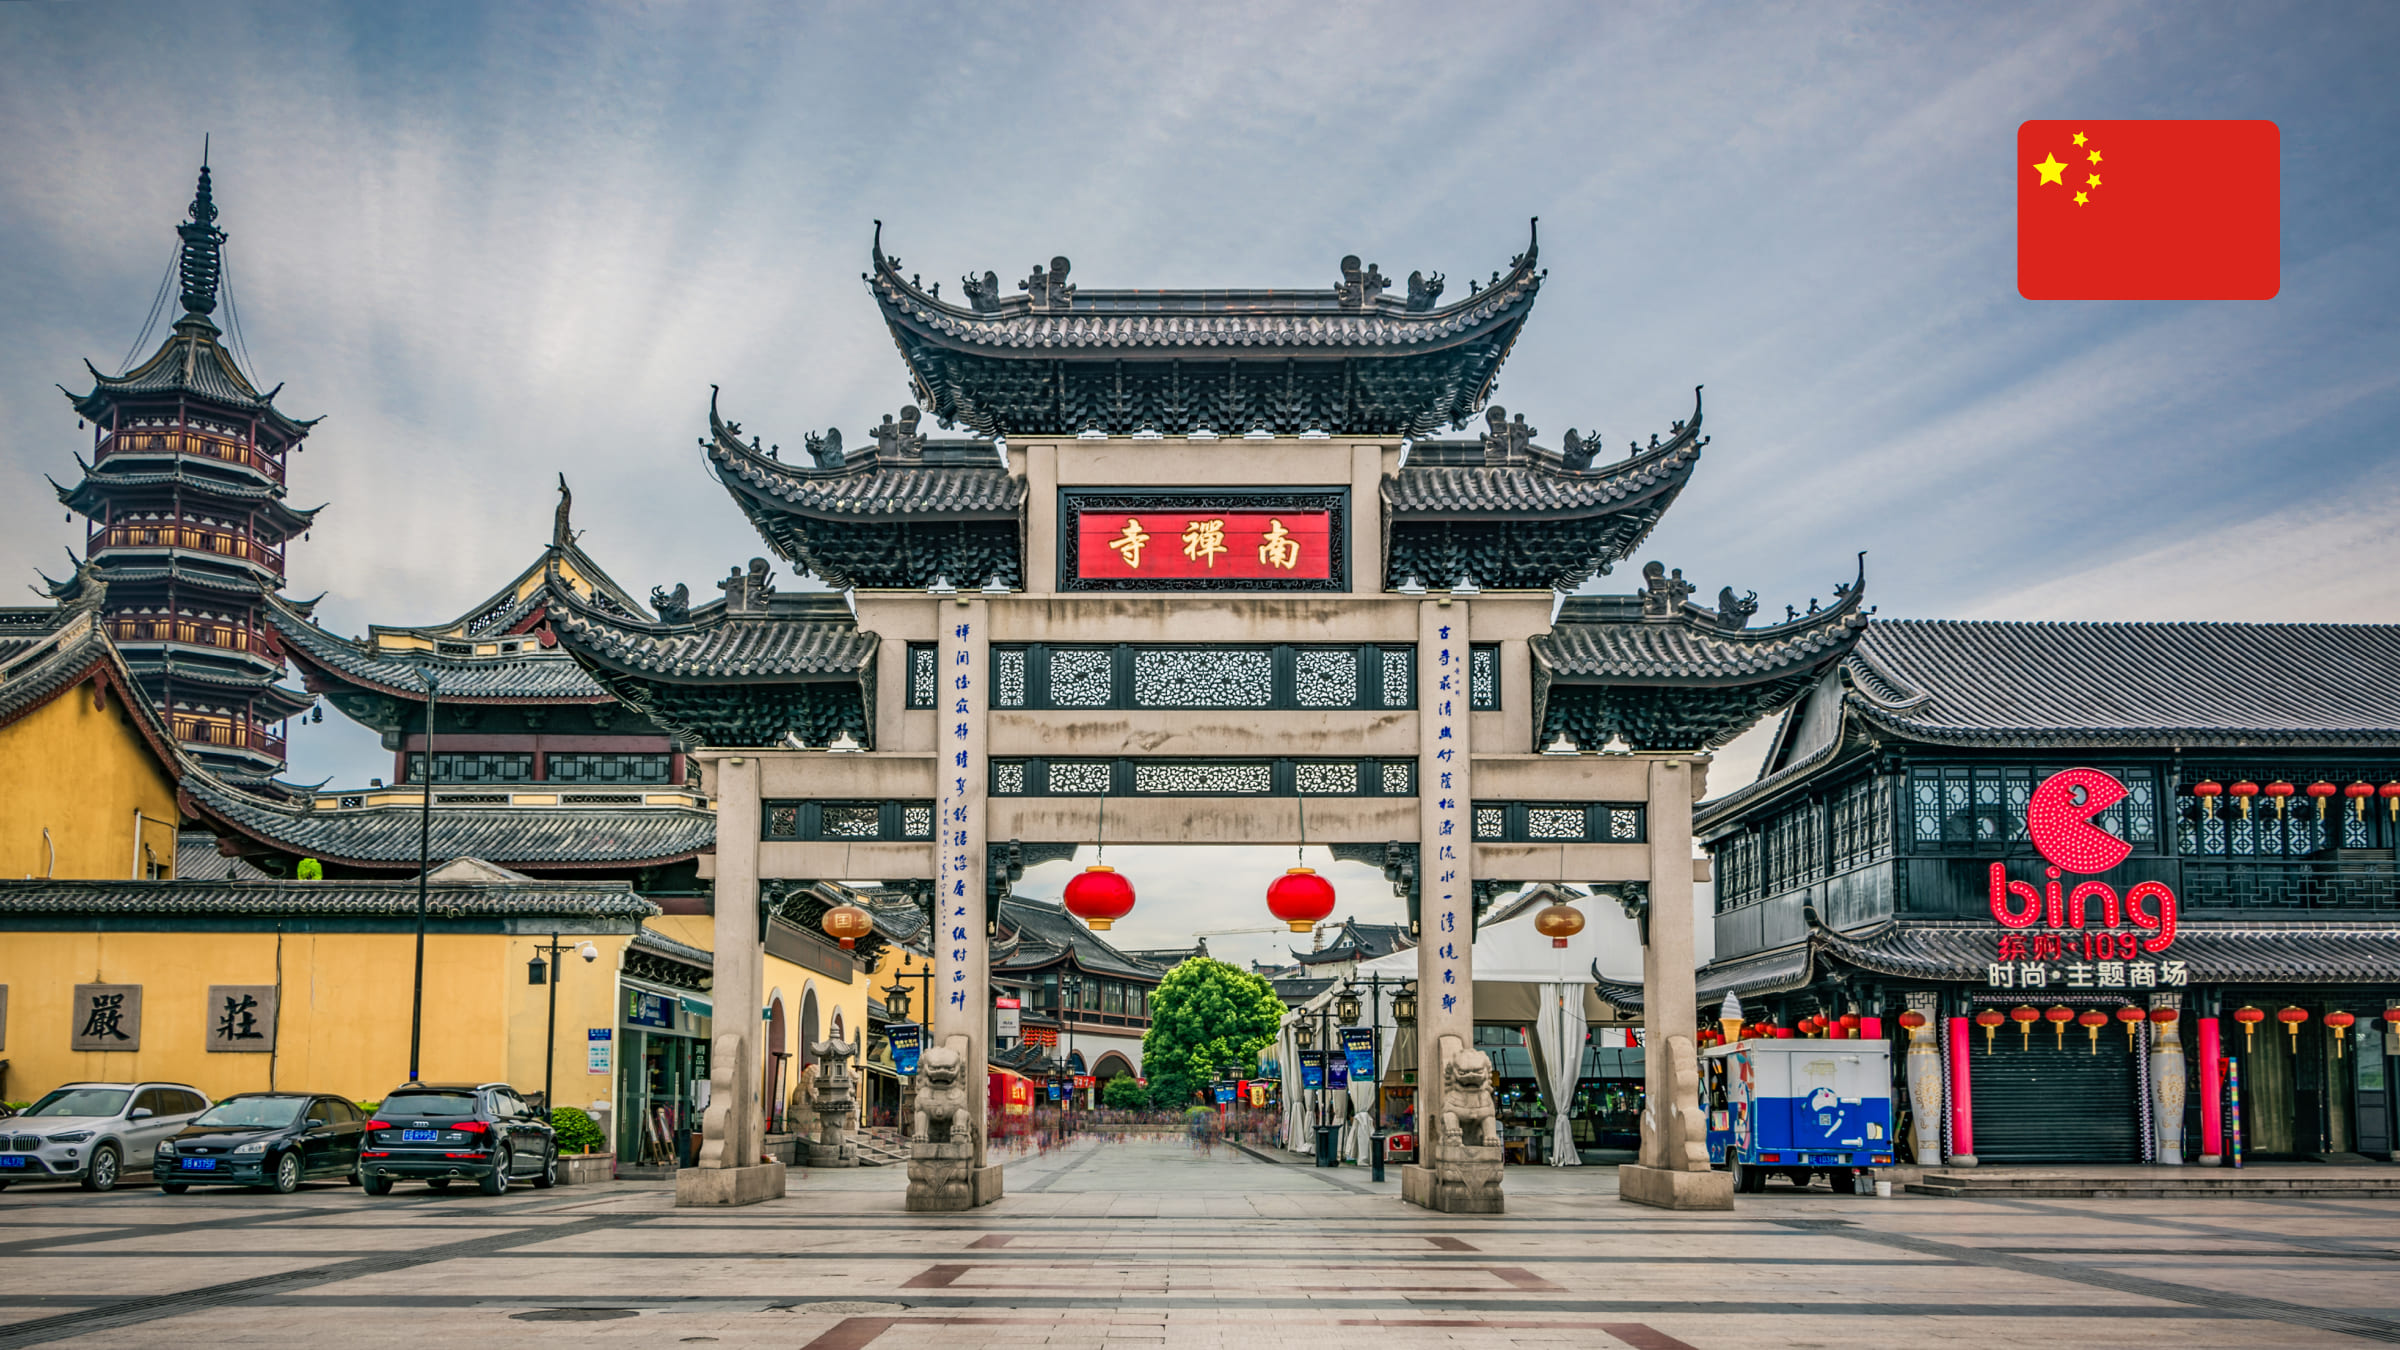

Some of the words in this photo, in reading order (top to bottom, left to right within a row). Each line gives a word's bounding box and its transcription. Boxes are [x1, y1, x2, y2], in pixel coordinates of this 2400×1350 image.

[1990, 862, 2177, 952] bing
[81, 993, 130, 1041] 嚴
[216, 994, 264, 1041] 莊
